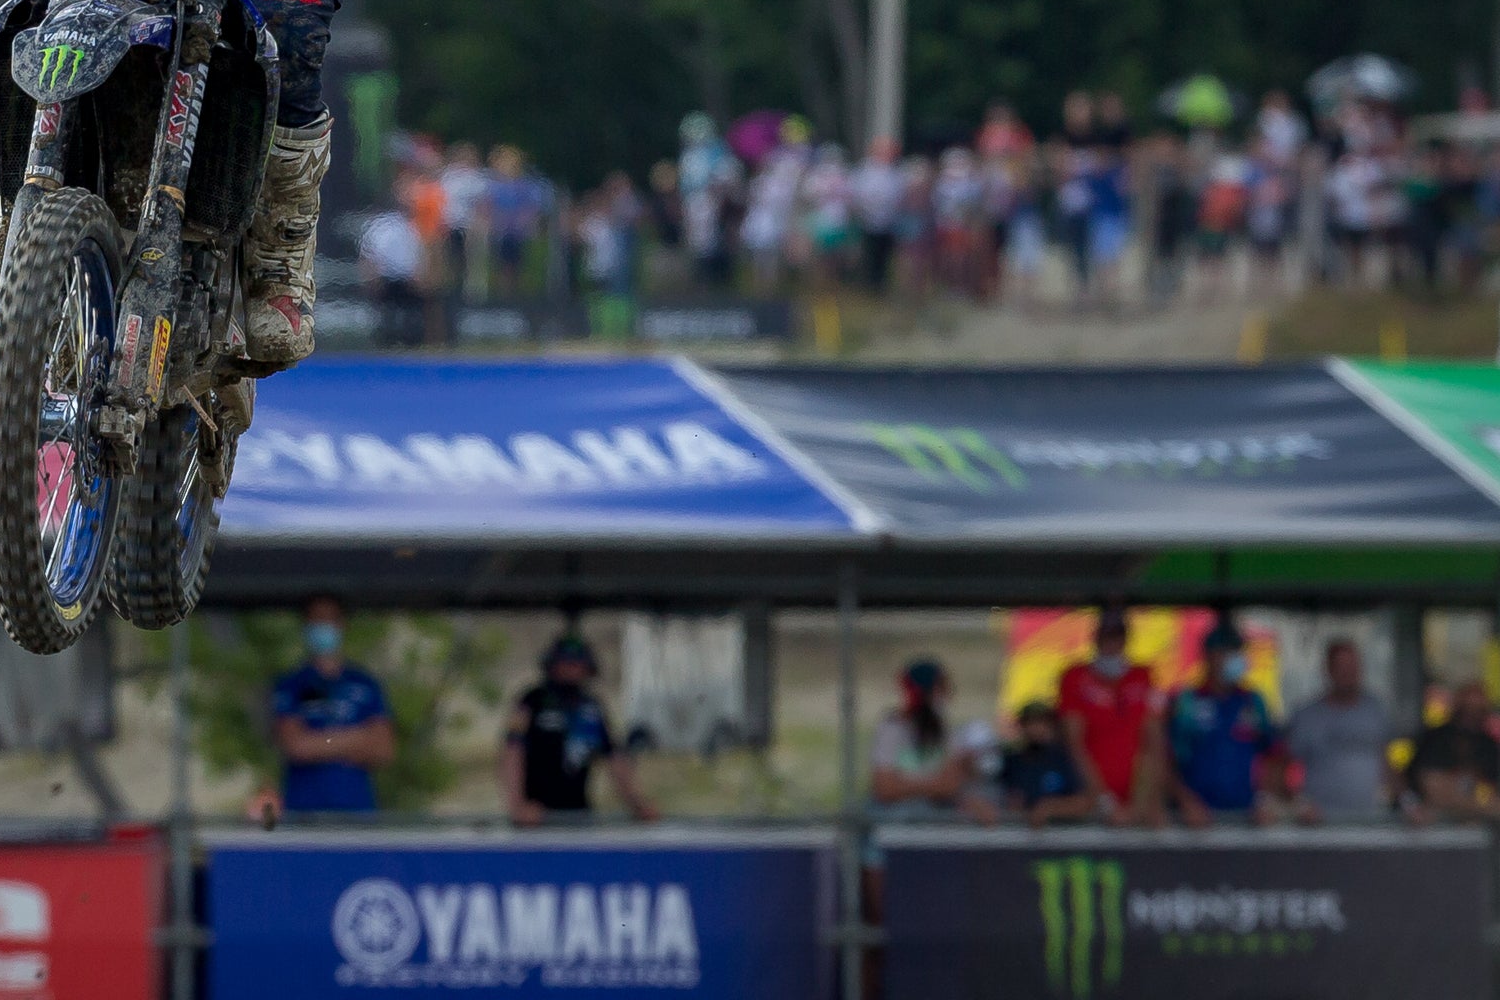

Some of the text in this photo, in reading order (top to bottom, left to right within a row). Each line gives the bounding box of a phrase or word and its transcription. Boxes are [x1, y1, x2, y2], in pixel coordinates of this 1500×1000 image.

[43, 30, 97, 47] YAMAHA
[264, 422, 770, 484] YAMAHA
[415, 883, 698, 964] YAMAHA
